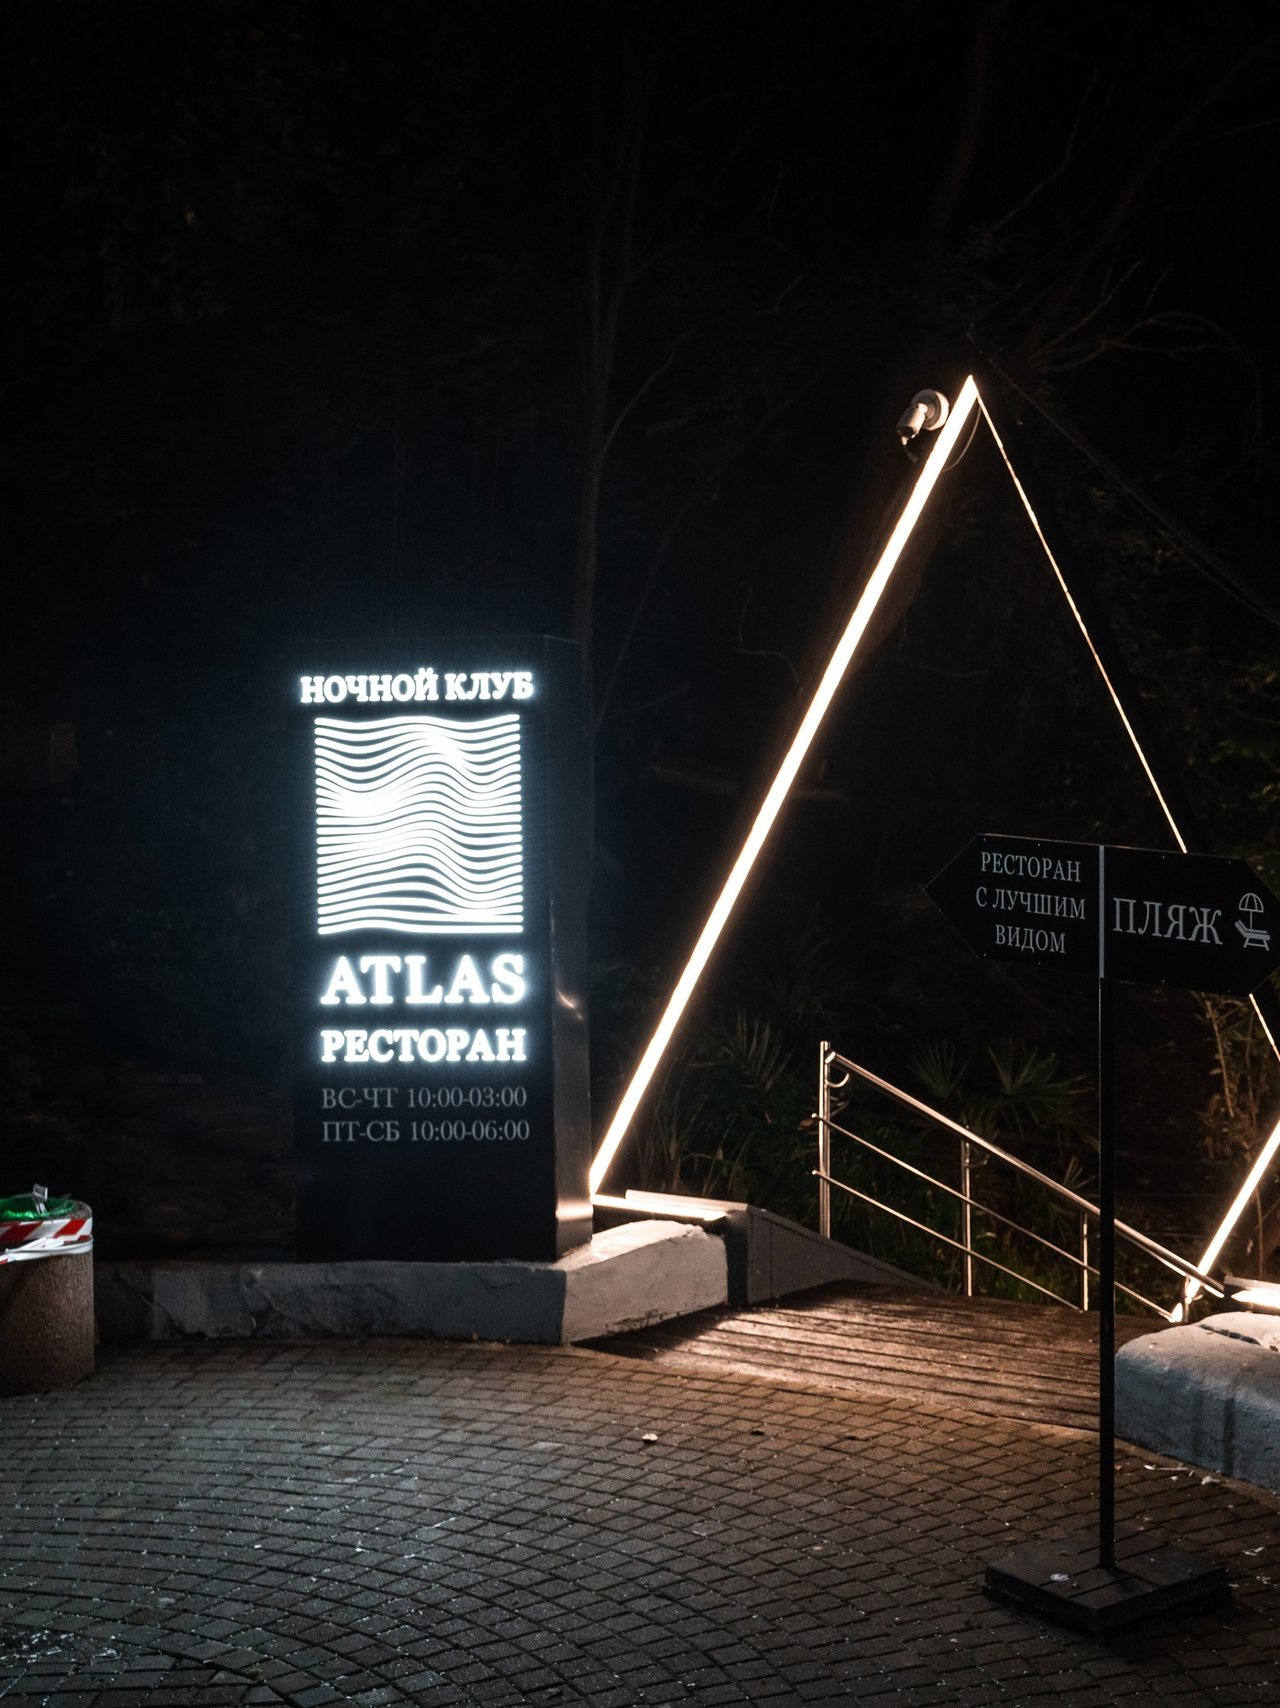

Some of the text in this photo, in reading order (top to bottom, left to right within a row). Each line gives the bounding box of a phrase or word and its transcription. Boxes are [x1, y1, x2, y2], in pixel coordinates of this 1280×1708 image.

[300, 667, 534, 703] НОЧНОЙ КЛУБ
[980, 851, 1081, 883] РЕСТОРАН
[975, 886, 1086, 920] С ЛУЧШИМ
[1112, 897, 1223, 945] ПЛЯЖ
[995, 924, 1067, 954] ВИДОМ
[320, 953, 526, 1005] ATLAS
[320, 1028, 527, 1063] РЕСТОРАН
[321, 1086, 527, 1109] ВС-ЧТ 10:00-03:00
[321, 1119, 530, 1142] ПТ-СБ 10:00-06:00
